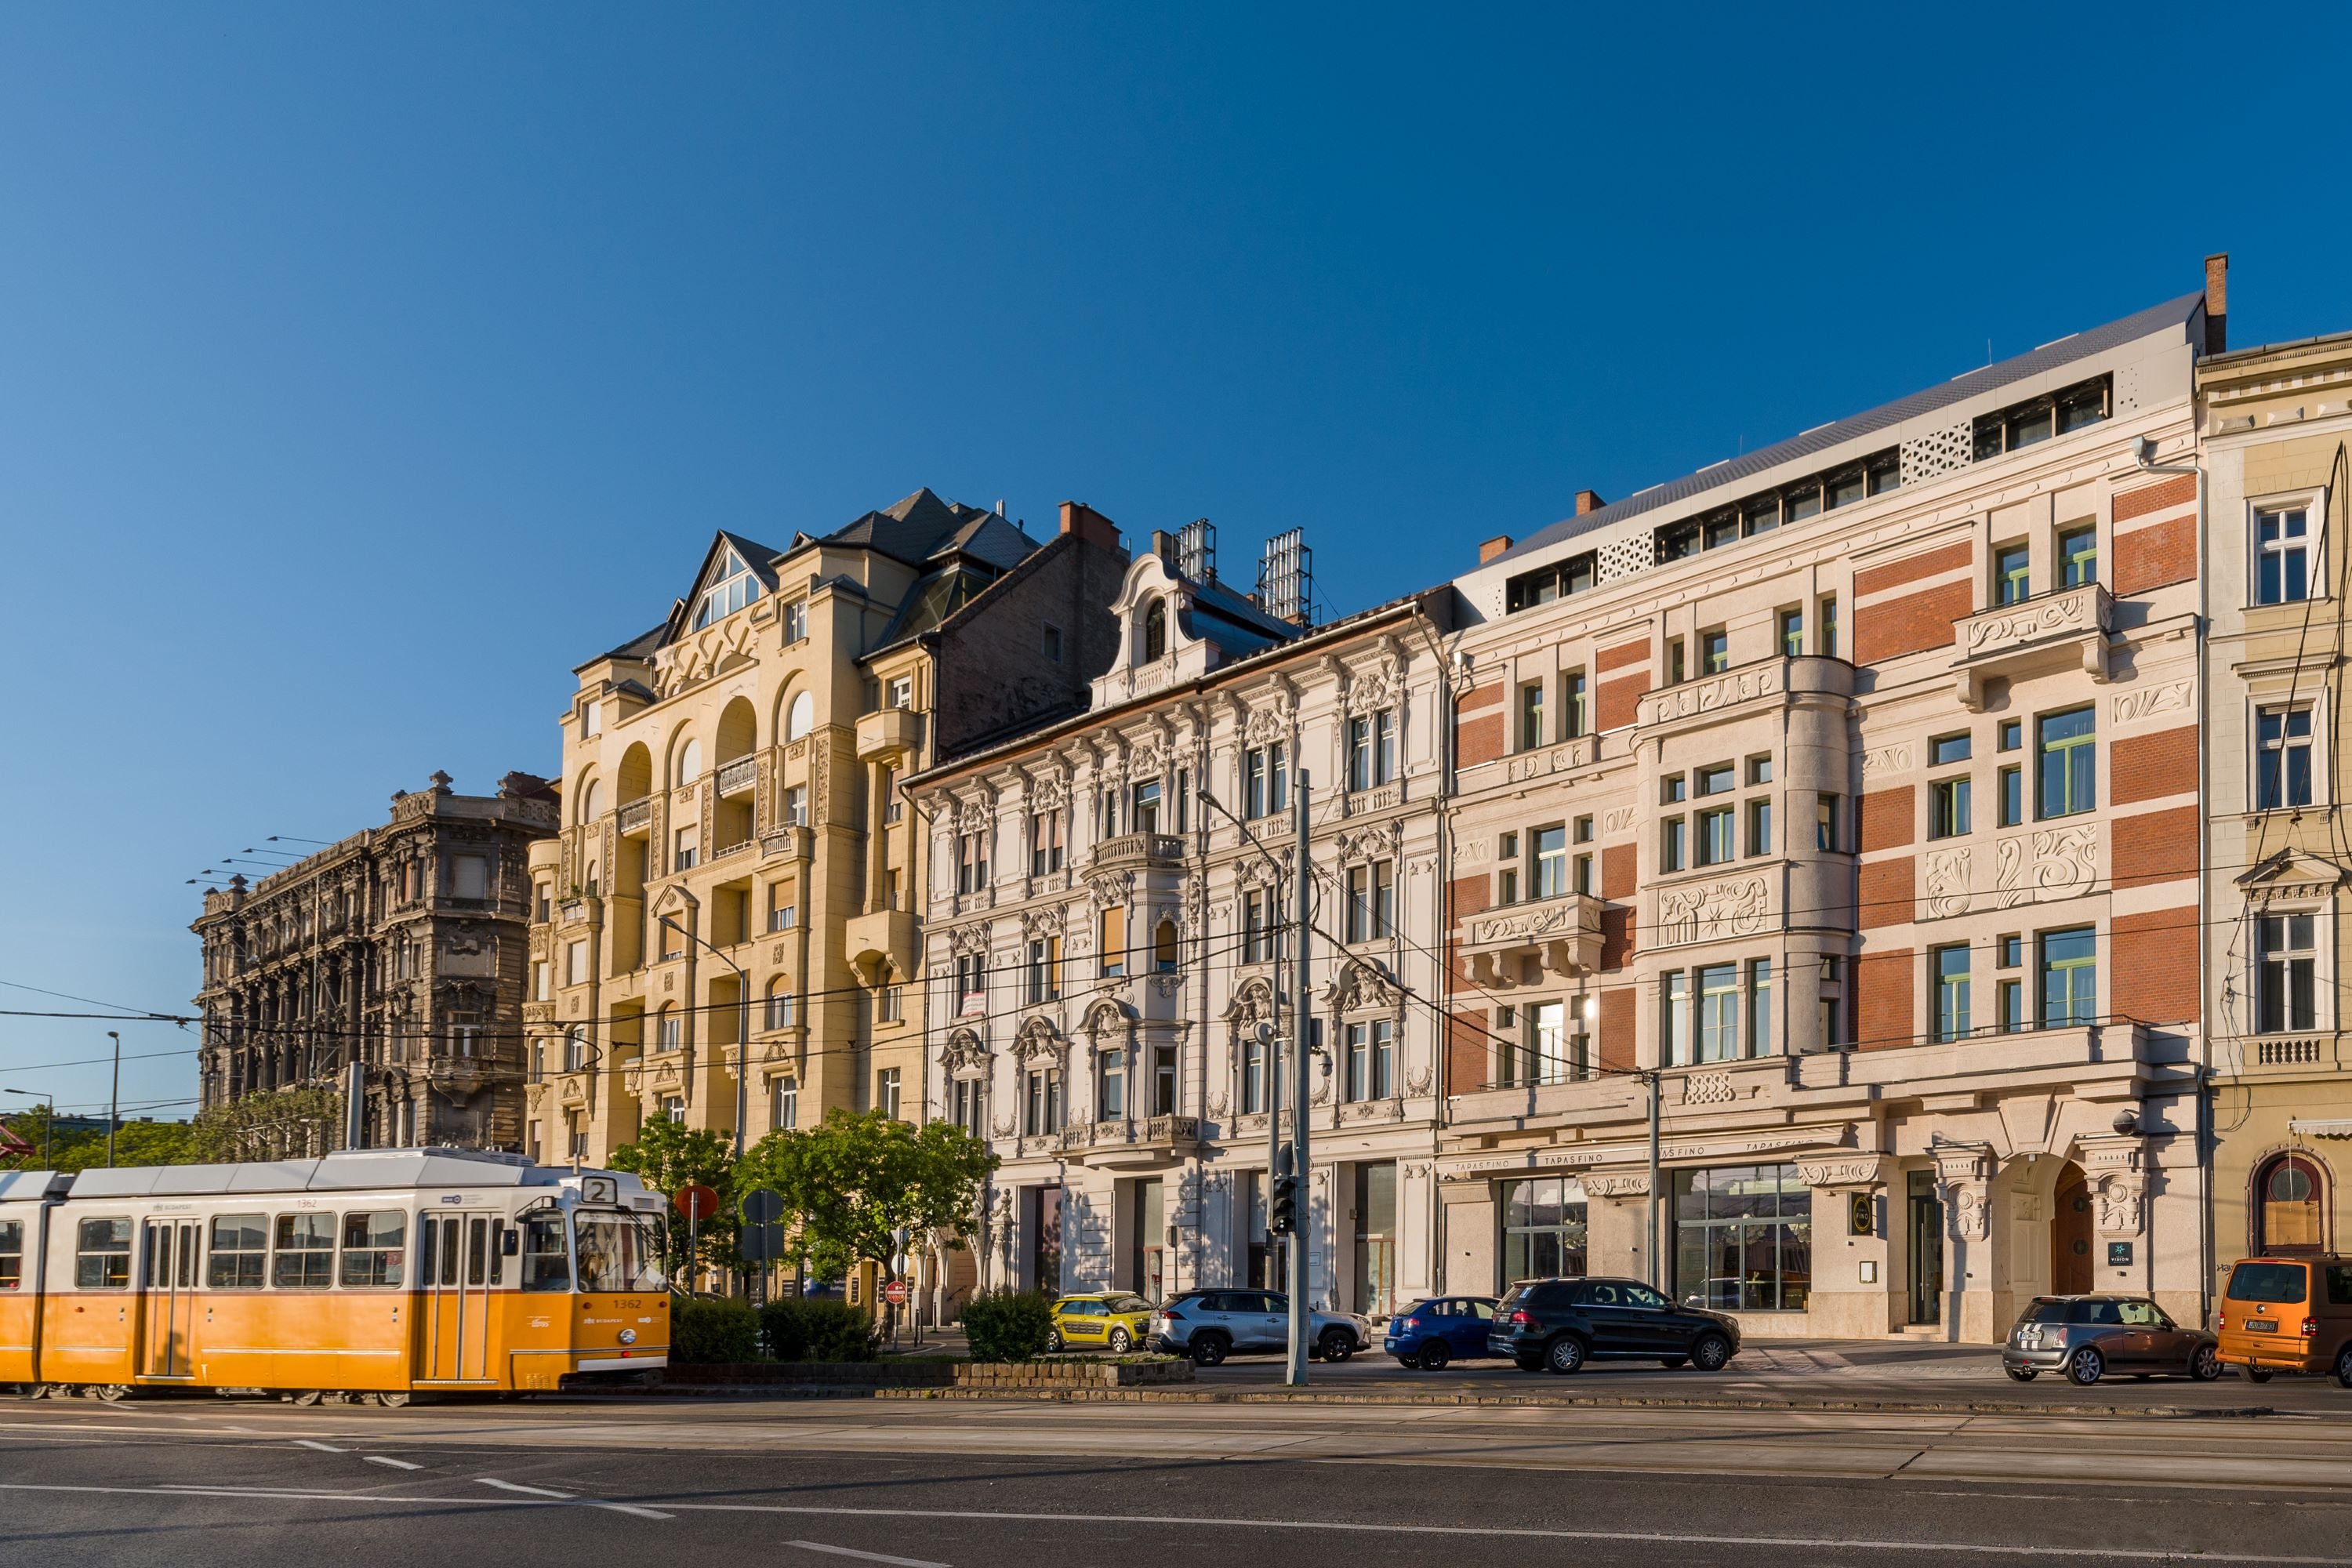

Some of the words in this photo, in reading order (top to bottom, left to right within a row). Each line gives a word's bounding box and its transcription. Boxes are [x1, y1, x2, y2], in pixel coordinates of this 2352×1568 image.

[1642, 1149, 1675, 1158] TAS
[1678, 1146, 1704, 1156] FINO
[1544, 1156, 1575, 1165] TAPAS
[1577, 1154, 1602, 1163] FINO
[590, 1181, 606, 1202] 2
[297, 1199, 318, 1208] 1362
[614, 1299, 641, 1309] 1362
